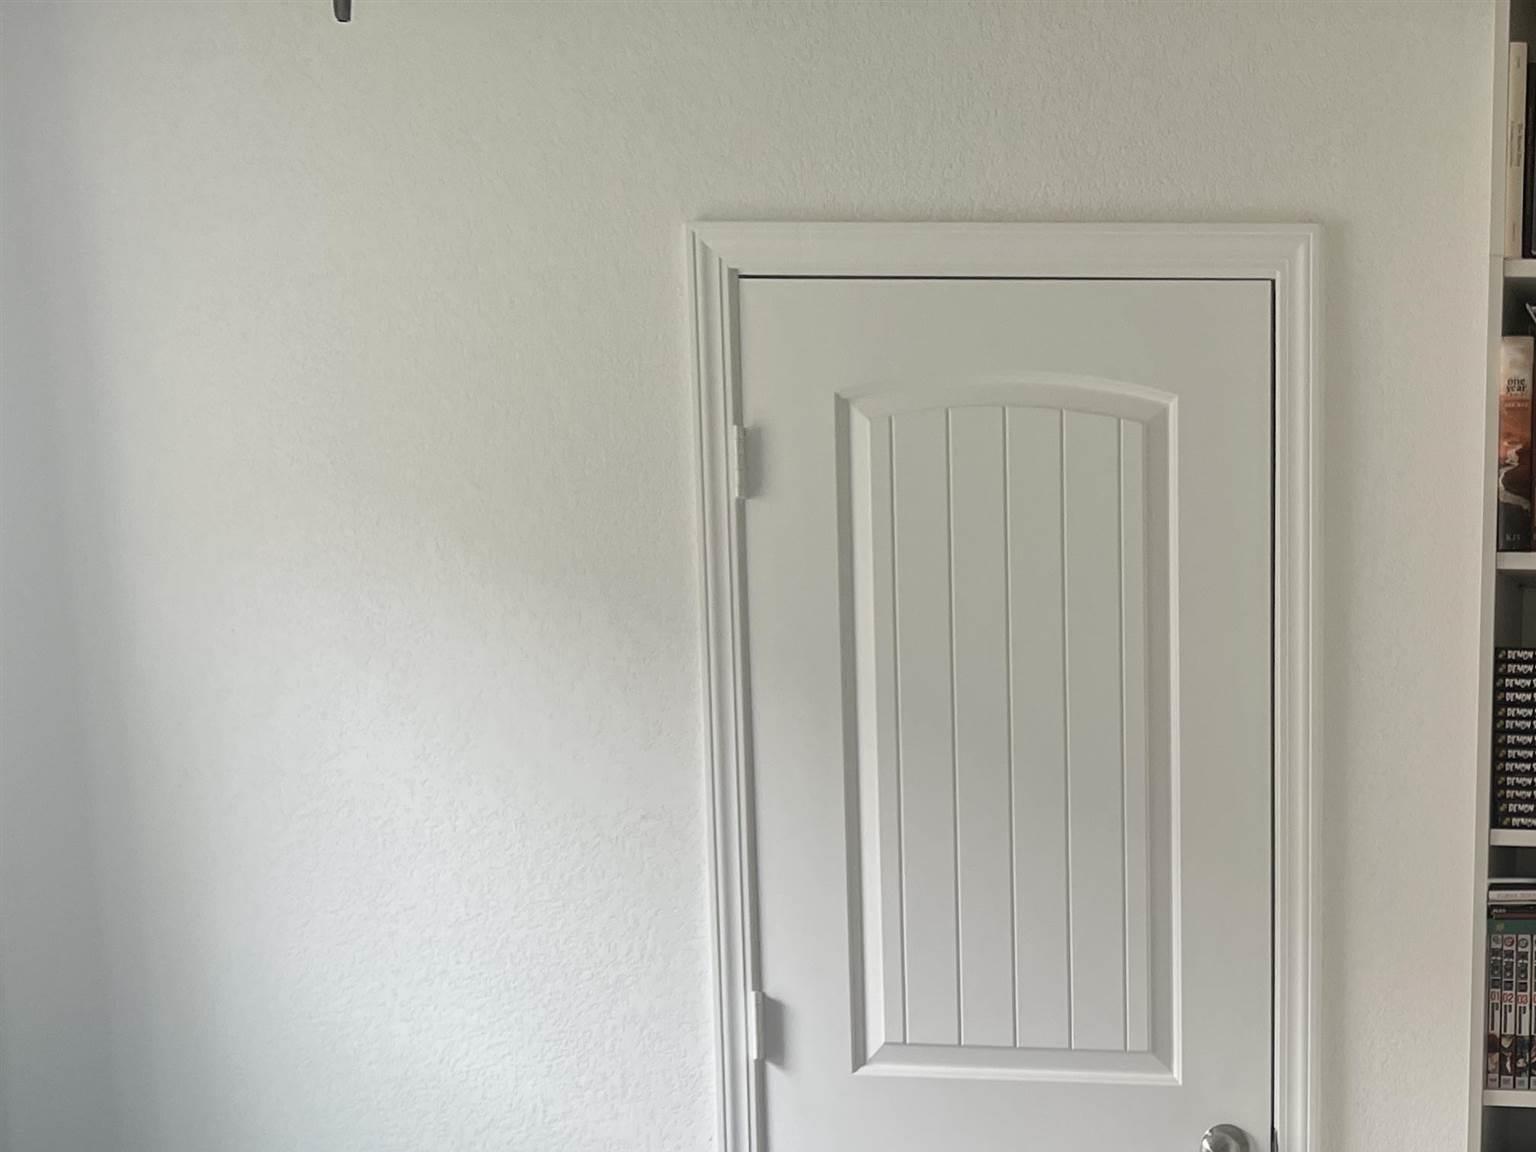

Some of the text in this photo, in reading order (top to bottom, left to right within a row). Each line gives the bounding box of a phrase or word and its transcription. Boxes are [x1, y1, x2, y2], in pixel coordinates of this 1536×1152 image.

[1507, 650, 1533, 660] DEMON
[1507, 664, 1533, 674] DEMON
[1505, 678, 1531, 688] DEMON
[1505, 692, 1532, 702] DEMON
